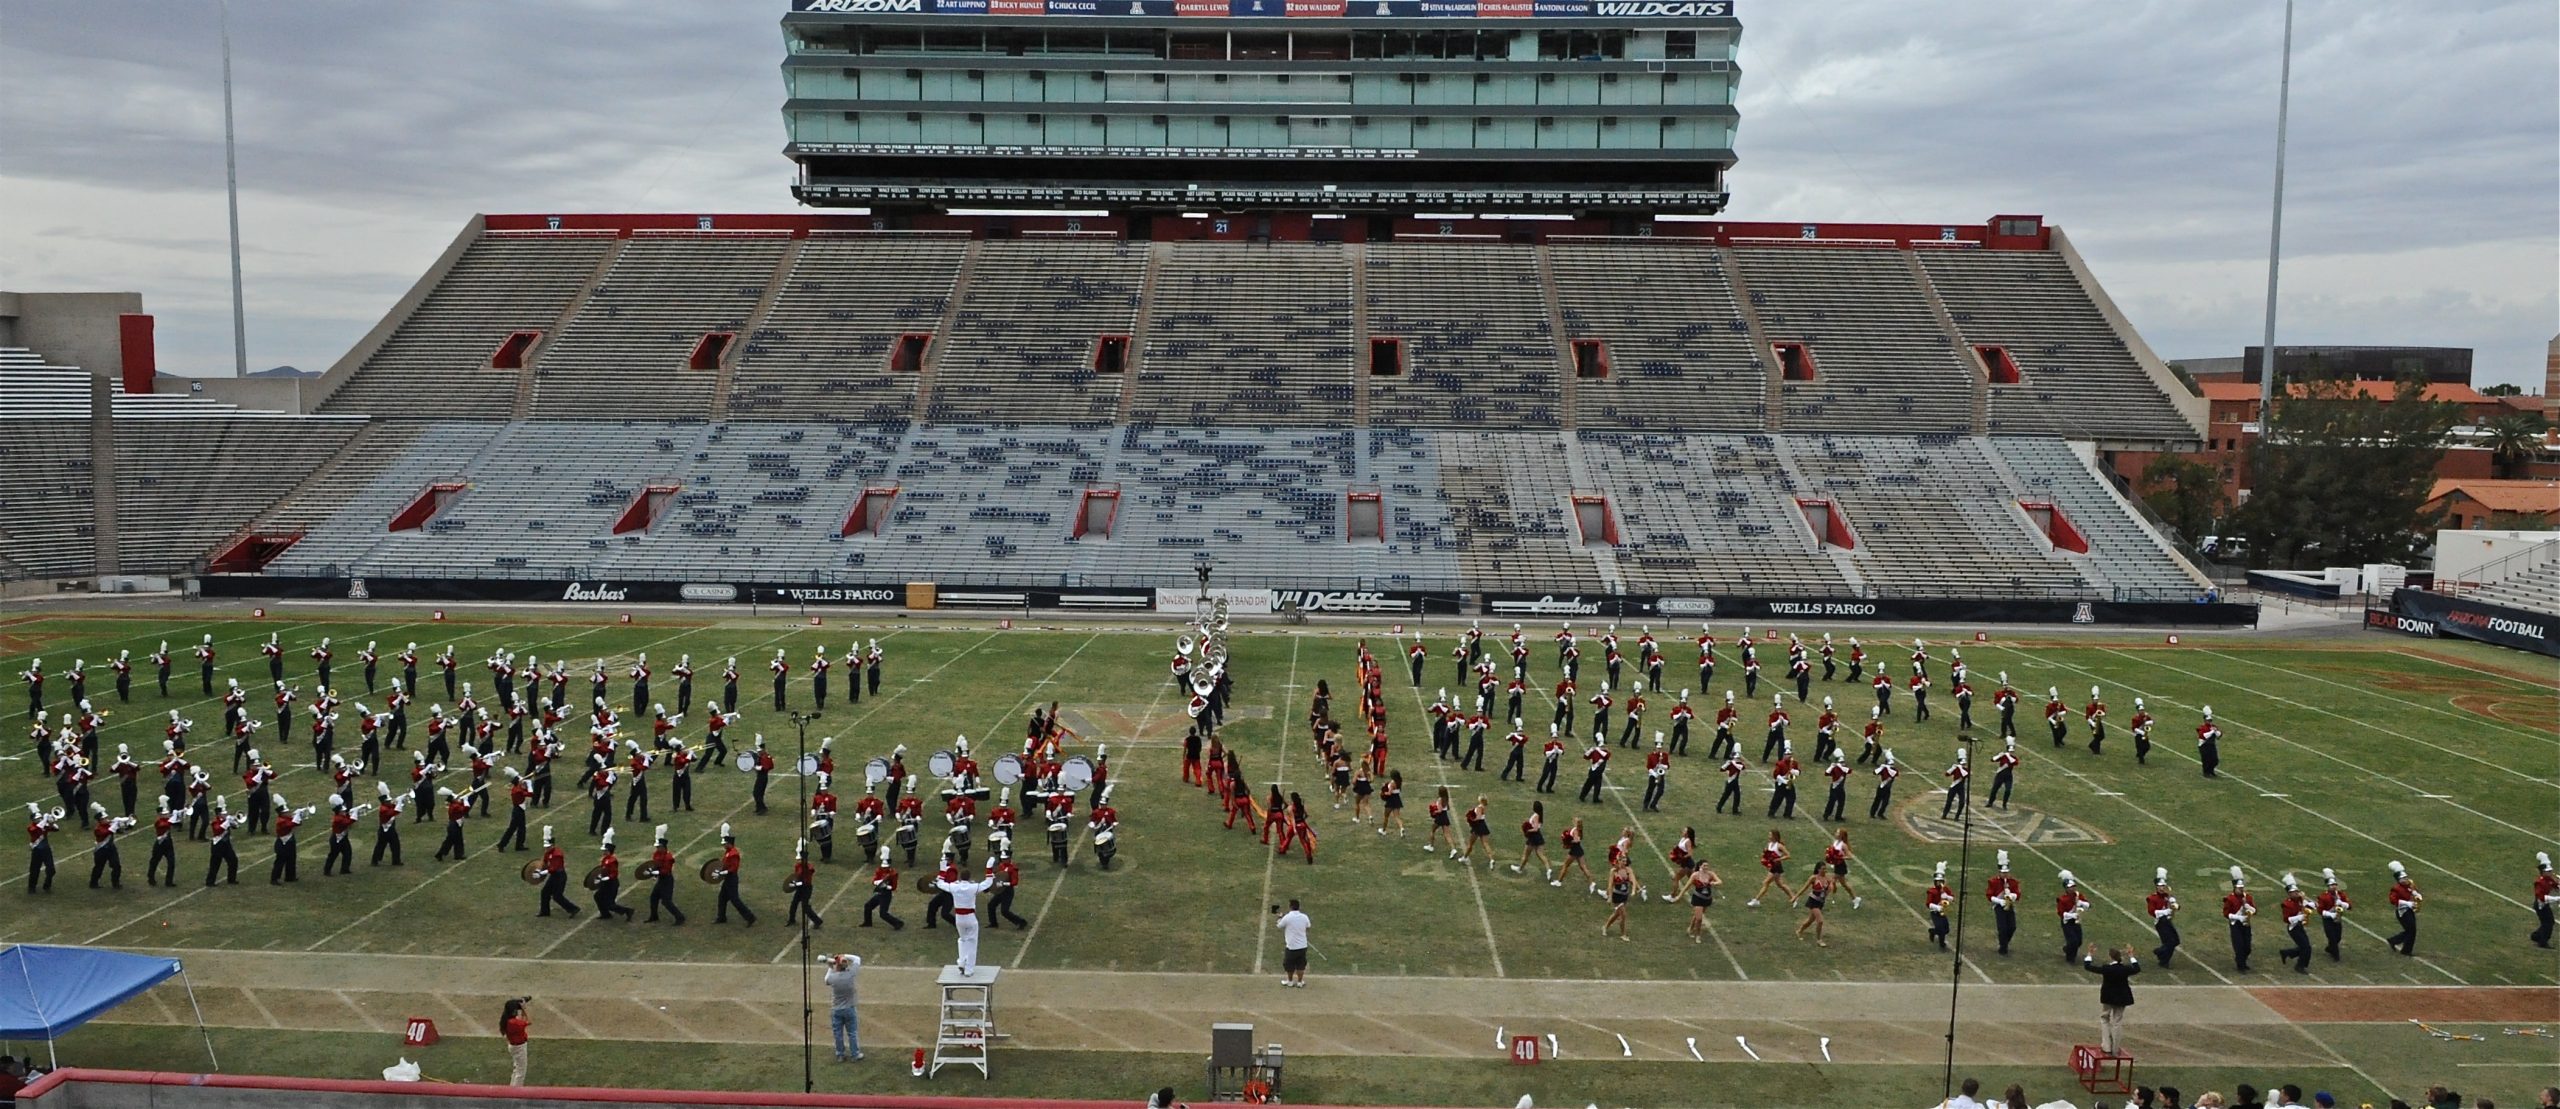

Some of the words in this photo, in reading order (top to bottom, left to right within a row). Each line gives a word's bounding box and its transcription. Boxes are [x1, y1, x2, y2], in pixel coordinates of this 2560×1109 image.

[806, 0, 922, 11] ARIZONA
[945, 1, 957, 9] ART
[958, 1, 986, 9] LUPPINO
[999, 1, 1018, 9] RICKY
[1019, 1, 1044, 9] HUNLEY
[1055, 2, 1077, 10] CHUCK
[1078, 2, 1097, 10] CECIL
[1539, 4, 1565, 12] ANTOINE
[1566, 4, 1588, 12] CASON
[1597, 2, 1727, 16] WILDCATS
[549, 221, 559, 229] 17
[700, 221, 711, 229] 18
[872, 222, 883, 230] 19
[1067, 223, 1080, 231] 20
[1216, 224, 1227, 232] 21
[1440, 226, 1453, 234] 22
[1639, 228, 1652, 236] 23
[1802, 230, 1815, 239] 24
[1942, 232, 1955, 240] 25
[192, 382, 202, 390] 16
[562, 582, 627, 600] Bashas'
[790, 589, 841, 600] WELLS
[844, 589, 894, 600] FARGO
[1159, 595, 1193, 605] UNIVERSITY
[1235, 596, 1254, 605] BAND
[1254, 596, 1267, 605] DAY
[1770, 603, 1822, 613] WELLS
[1825, 603, 1875, 614] FARGO
[2369, 612, 2397, 630] BEAR
[2397, 617, 2434, 635] DOWN
[2447, 610, 2489, 630] ARIZONA
[2487, 617, 2545, 639] FOOTBALL
[407, 1022, 426, 1042] 40
[1516, 1040, 1534, 1060] 40
